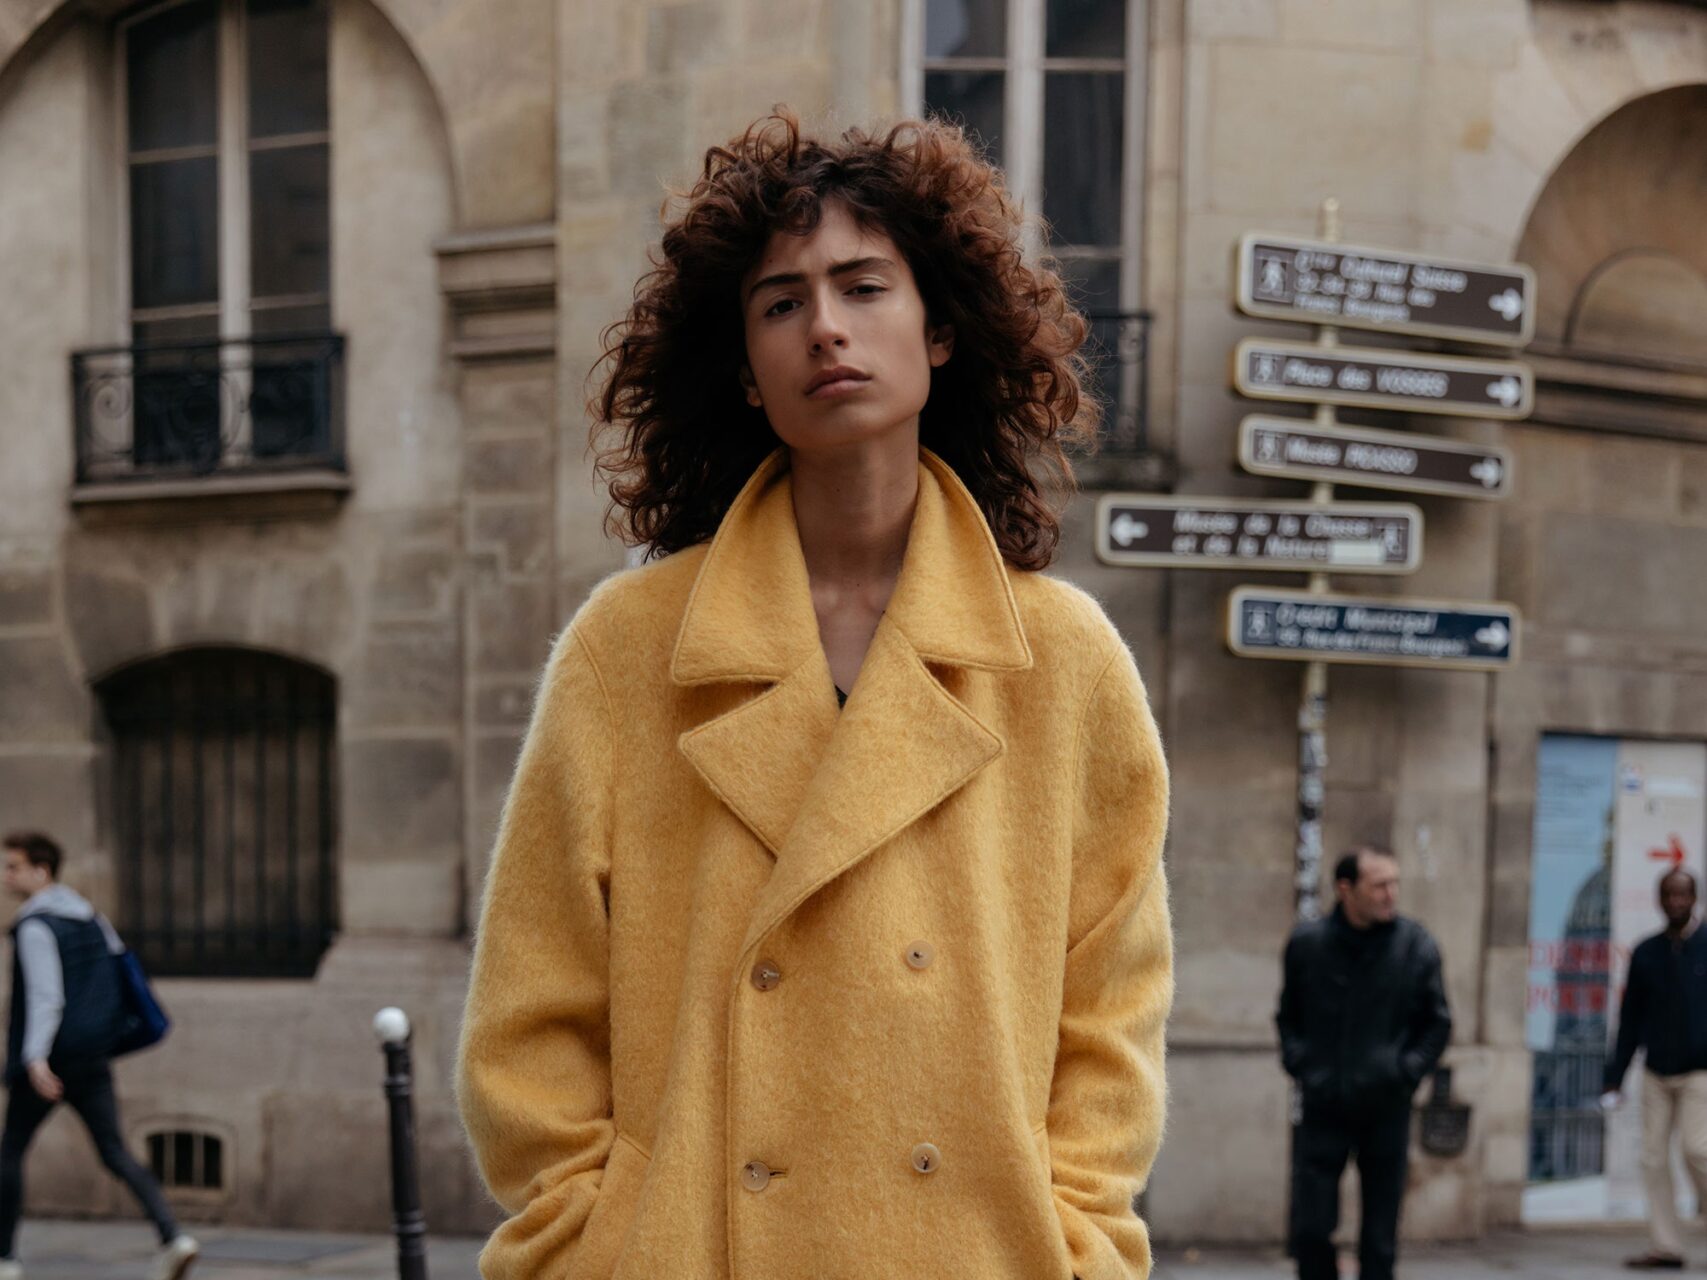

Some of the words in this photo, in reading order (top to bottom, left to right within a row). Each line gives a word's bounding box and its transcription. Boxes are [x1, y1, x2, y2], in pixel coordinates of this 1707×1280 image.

[1413, 266, 1466, 292] Suisse
[1285, 360, 1332, 386] Place
[1339, 366, 1370, 389] des
[1379, 369, 1448, 396] VOSGES
[1288, 438, 1340, 464] Musée
[1346, 445, 1417, 472] PICASSO
[1175, 511, 1237, 534] Musée
[1245, 512, 1270, 535] de
[1278, 513, 1299, 536] la
[1307, 515, 1372, 538] Chasse
[1173, 535, 1196, 555] et
[1205, 535, 1230, 556] de
[1238, 536, 1258, 557] la
[1265, 538, 1328, 558] Nature
[1278, 604, 1337, 628] Crédit
[1345, 607, 1436, 634] Municipal
